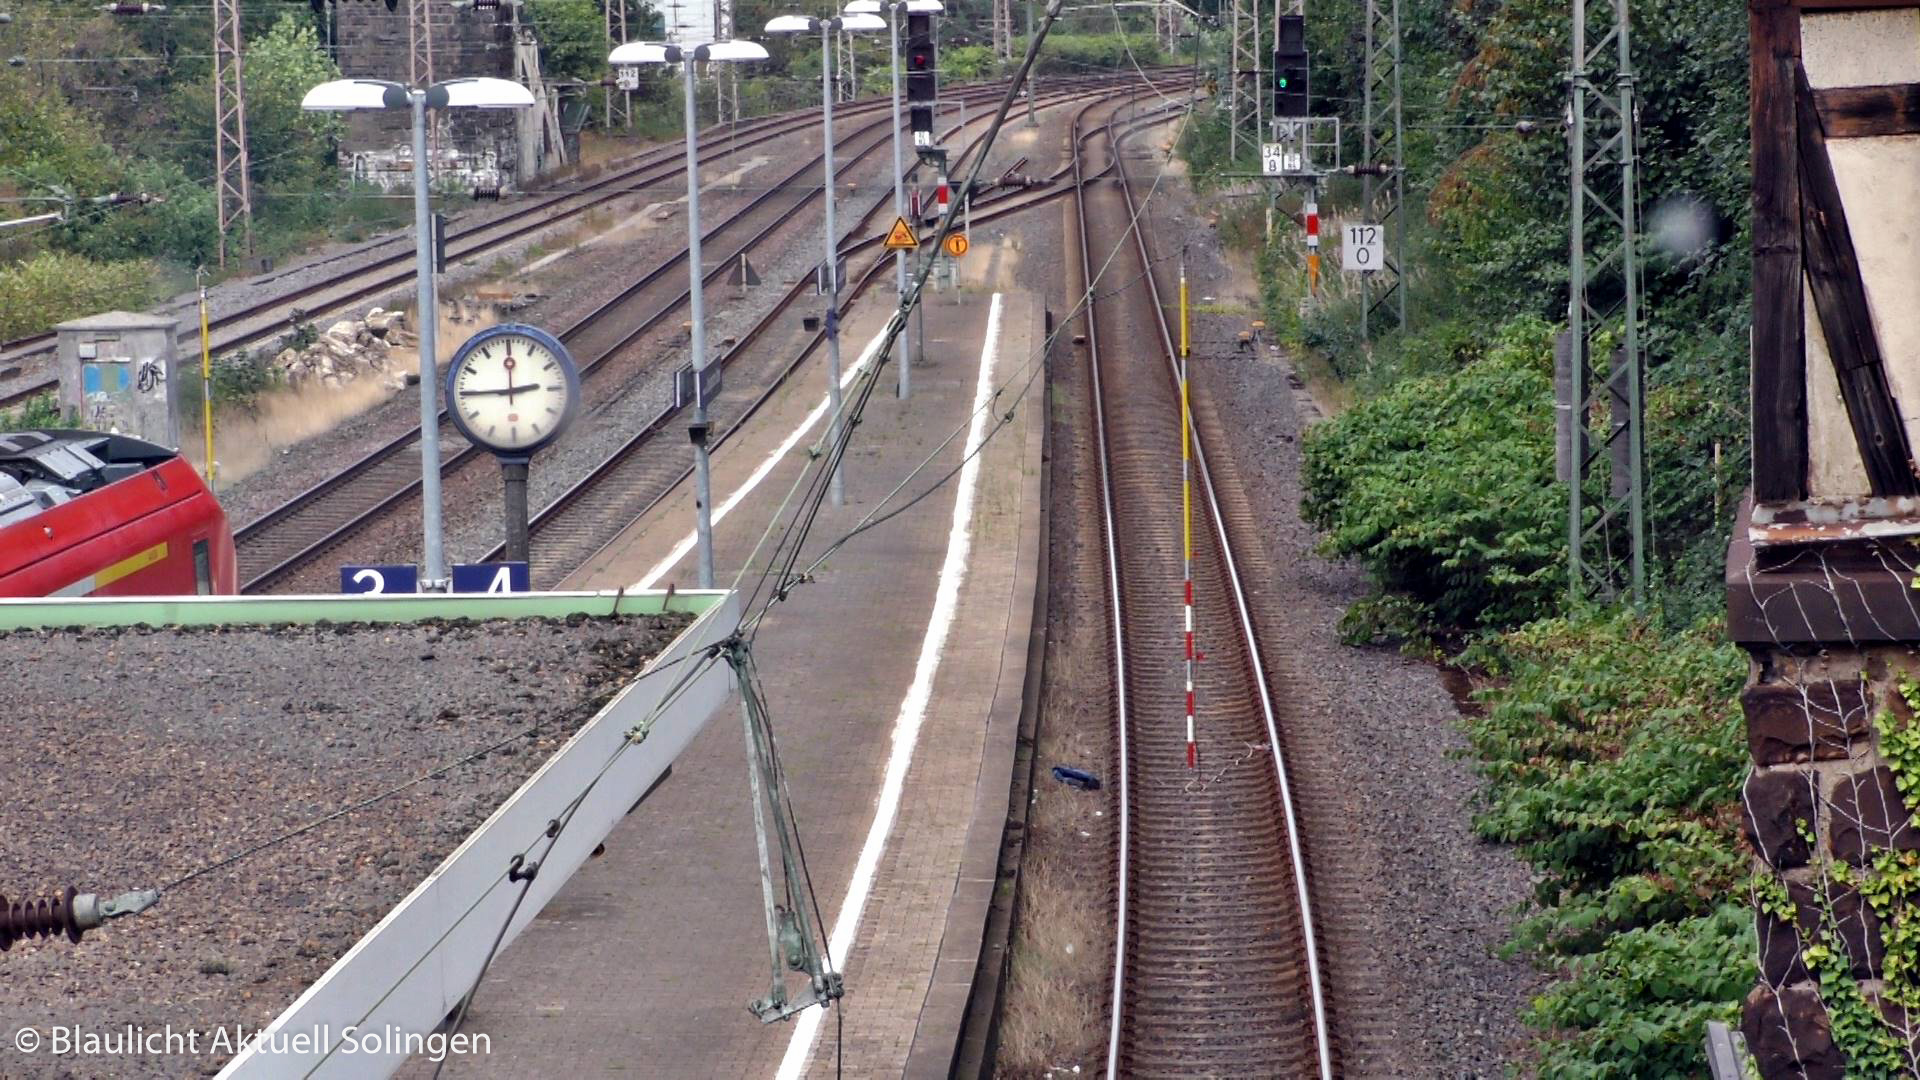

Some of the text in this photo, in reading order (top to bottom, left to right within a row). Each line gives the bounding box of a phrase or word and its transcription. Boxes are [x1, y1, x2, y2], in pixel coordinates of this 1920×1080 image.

[1263, 145, 1280, 158] 34
[1350, 227, 1377, 246] 112
[1356, 247, 1370, 265] 0
